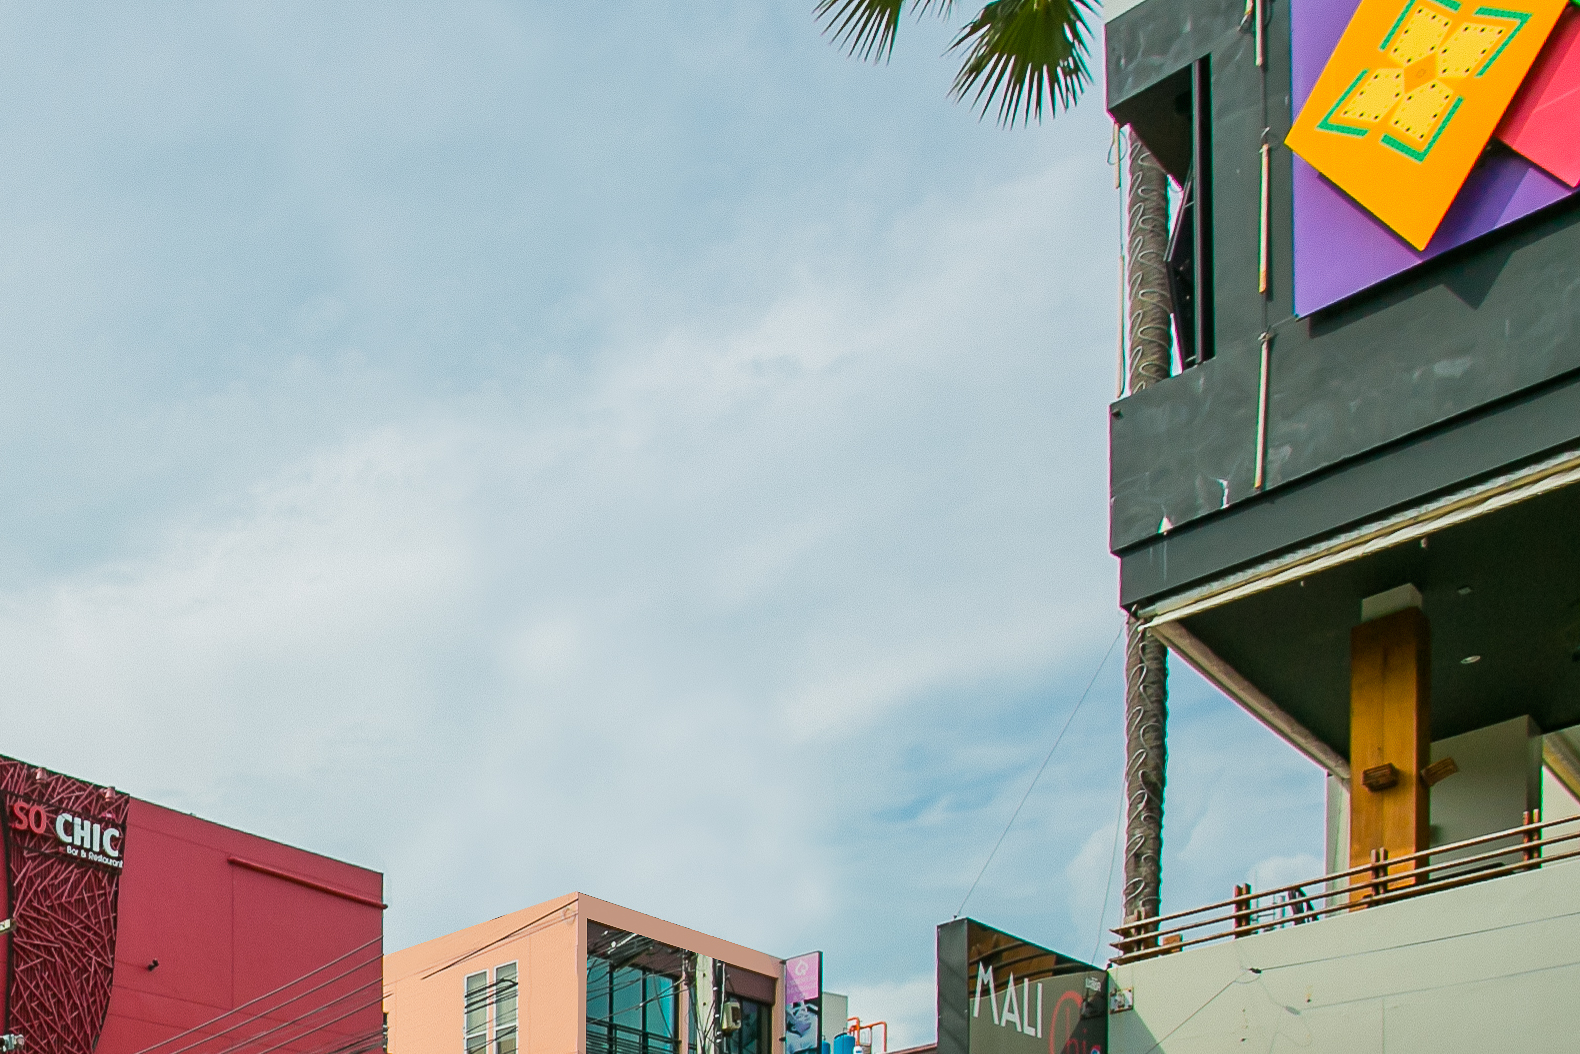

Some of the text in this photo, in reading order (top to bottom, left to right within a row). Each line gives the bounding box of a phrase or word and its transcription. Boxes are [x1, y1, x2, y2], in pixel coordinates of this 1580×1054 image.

[12, 801, 121, 858] SO CHIC
[88, 851, 123, 868] Restaurant
[972, 960, 1043, 1039] MALI
